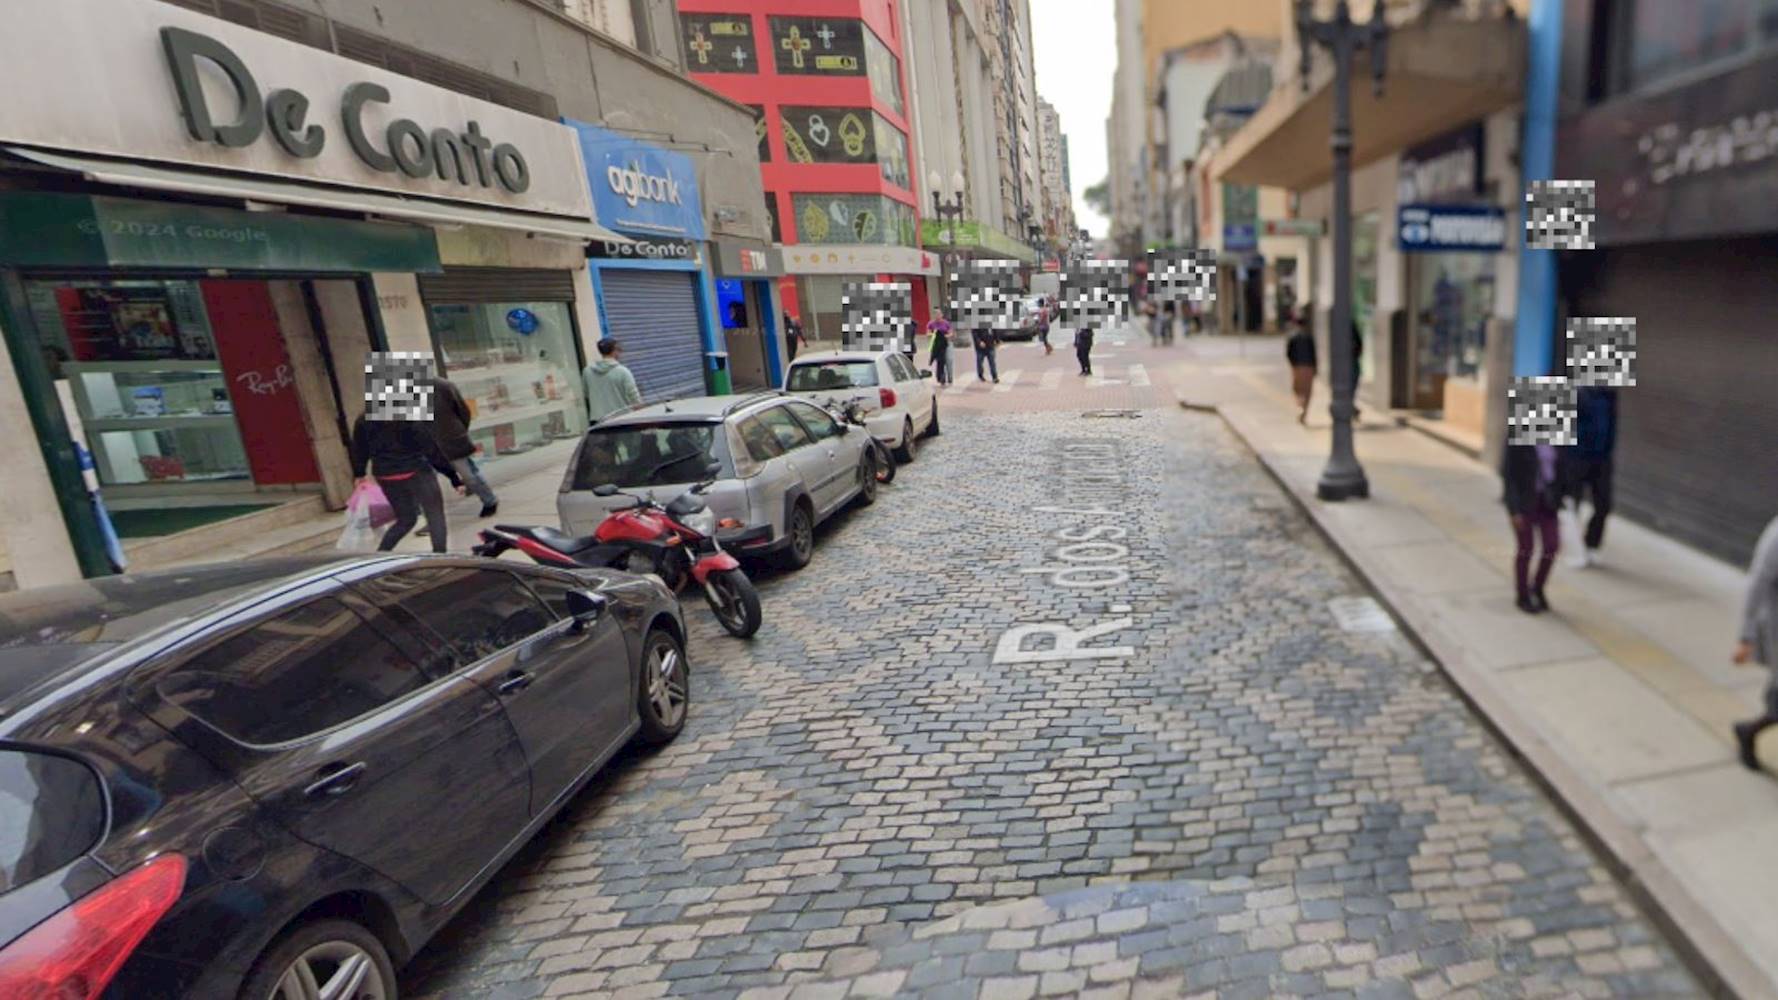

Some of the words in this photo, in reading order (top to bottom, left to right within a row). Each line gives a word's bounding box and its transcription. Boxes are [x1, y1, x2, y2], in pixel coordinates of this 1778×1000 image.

[159, 25, 325, 159] De
[341, 81, 531, 194] Conto
[604, 240, 632, 255] De
[635, 241, 688, 256] Conto
